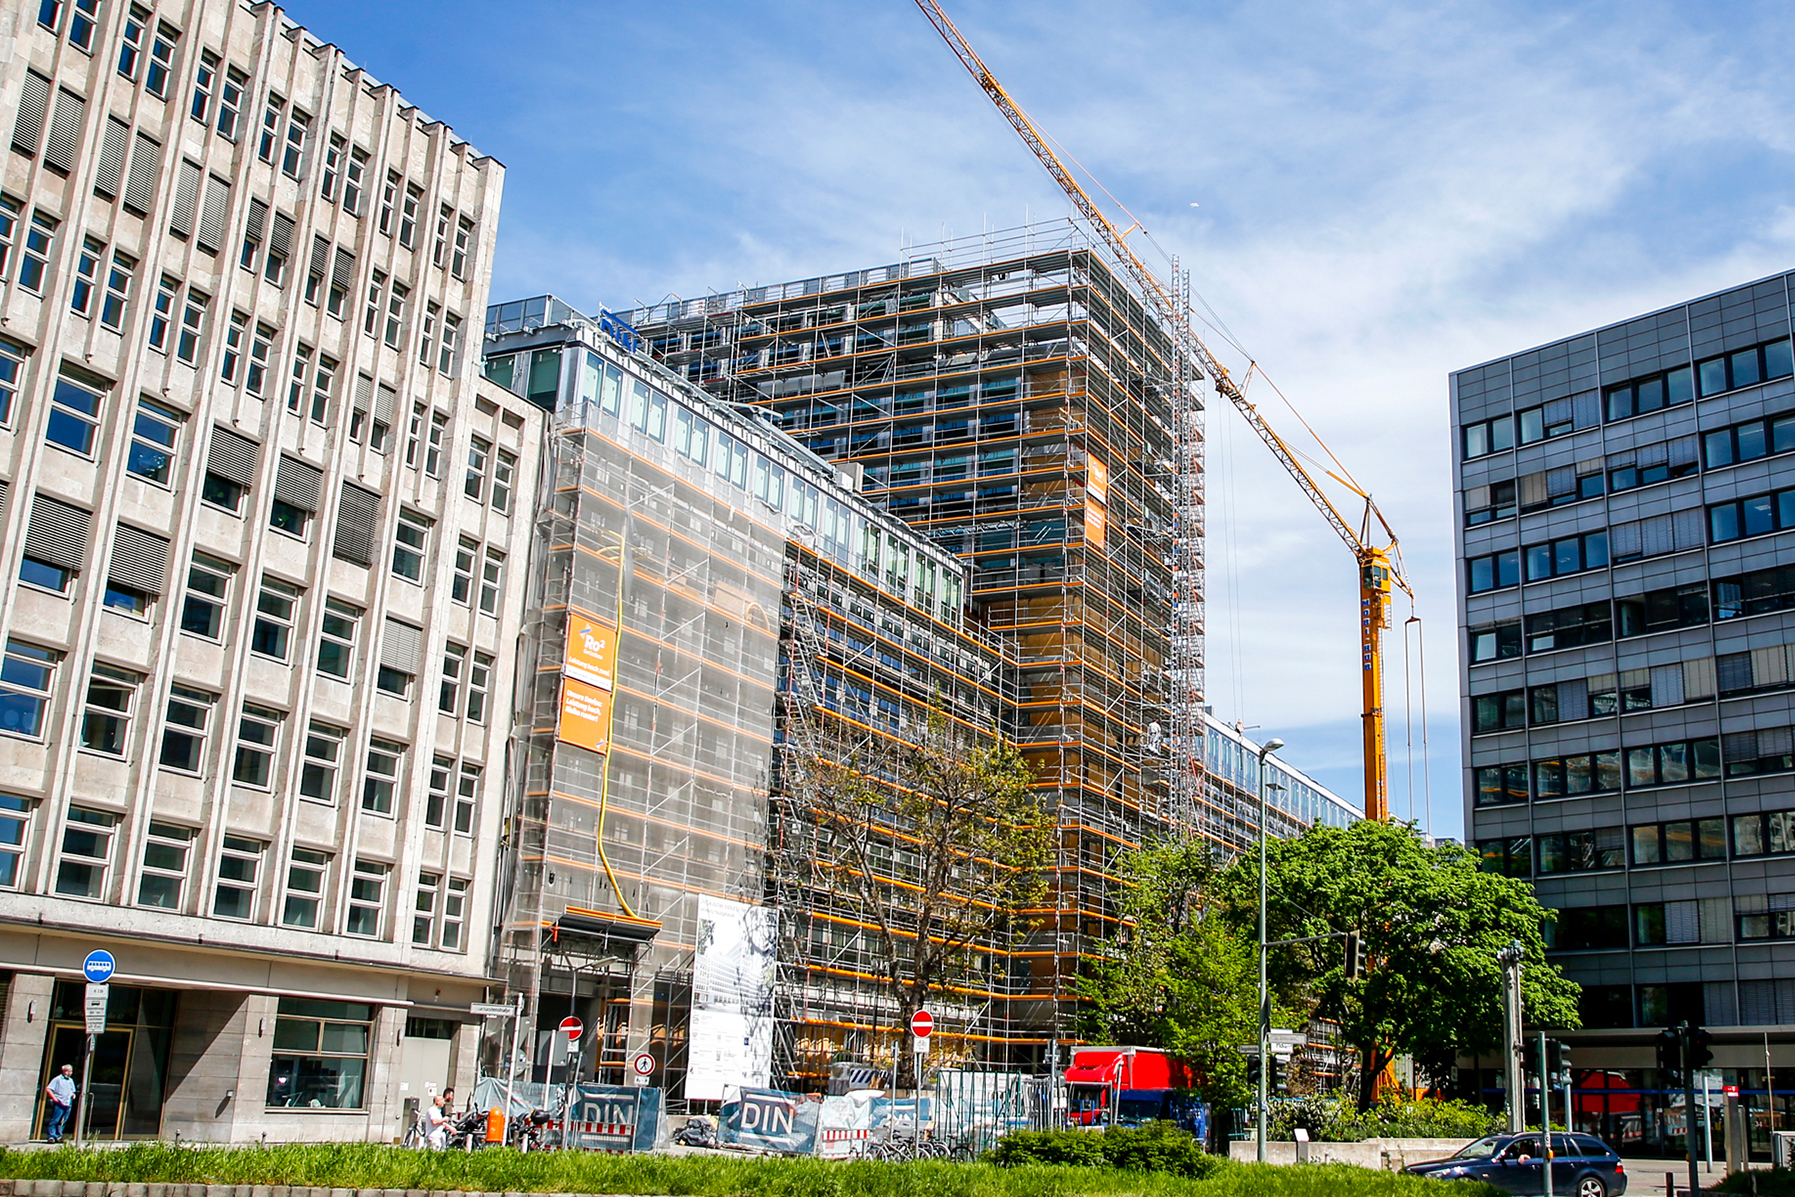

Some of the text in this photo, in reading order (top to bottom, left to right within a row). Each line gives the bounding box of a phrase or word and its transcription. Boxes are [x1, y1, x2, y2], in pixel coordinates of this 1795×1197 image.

[600, 317, 638, 354] DIN
[1362, 598, 1371, 671] MOBI-HUB
[568, 656, 588, 669] Leistung
[587, 663, 599, 672] hoch
[566, 689, 584, 701] Unsere
[566, 698, 588, 711] Leistung
[583, 1102, 634, 1125] DIN
[740, 1101, 794, 1135] DIN
